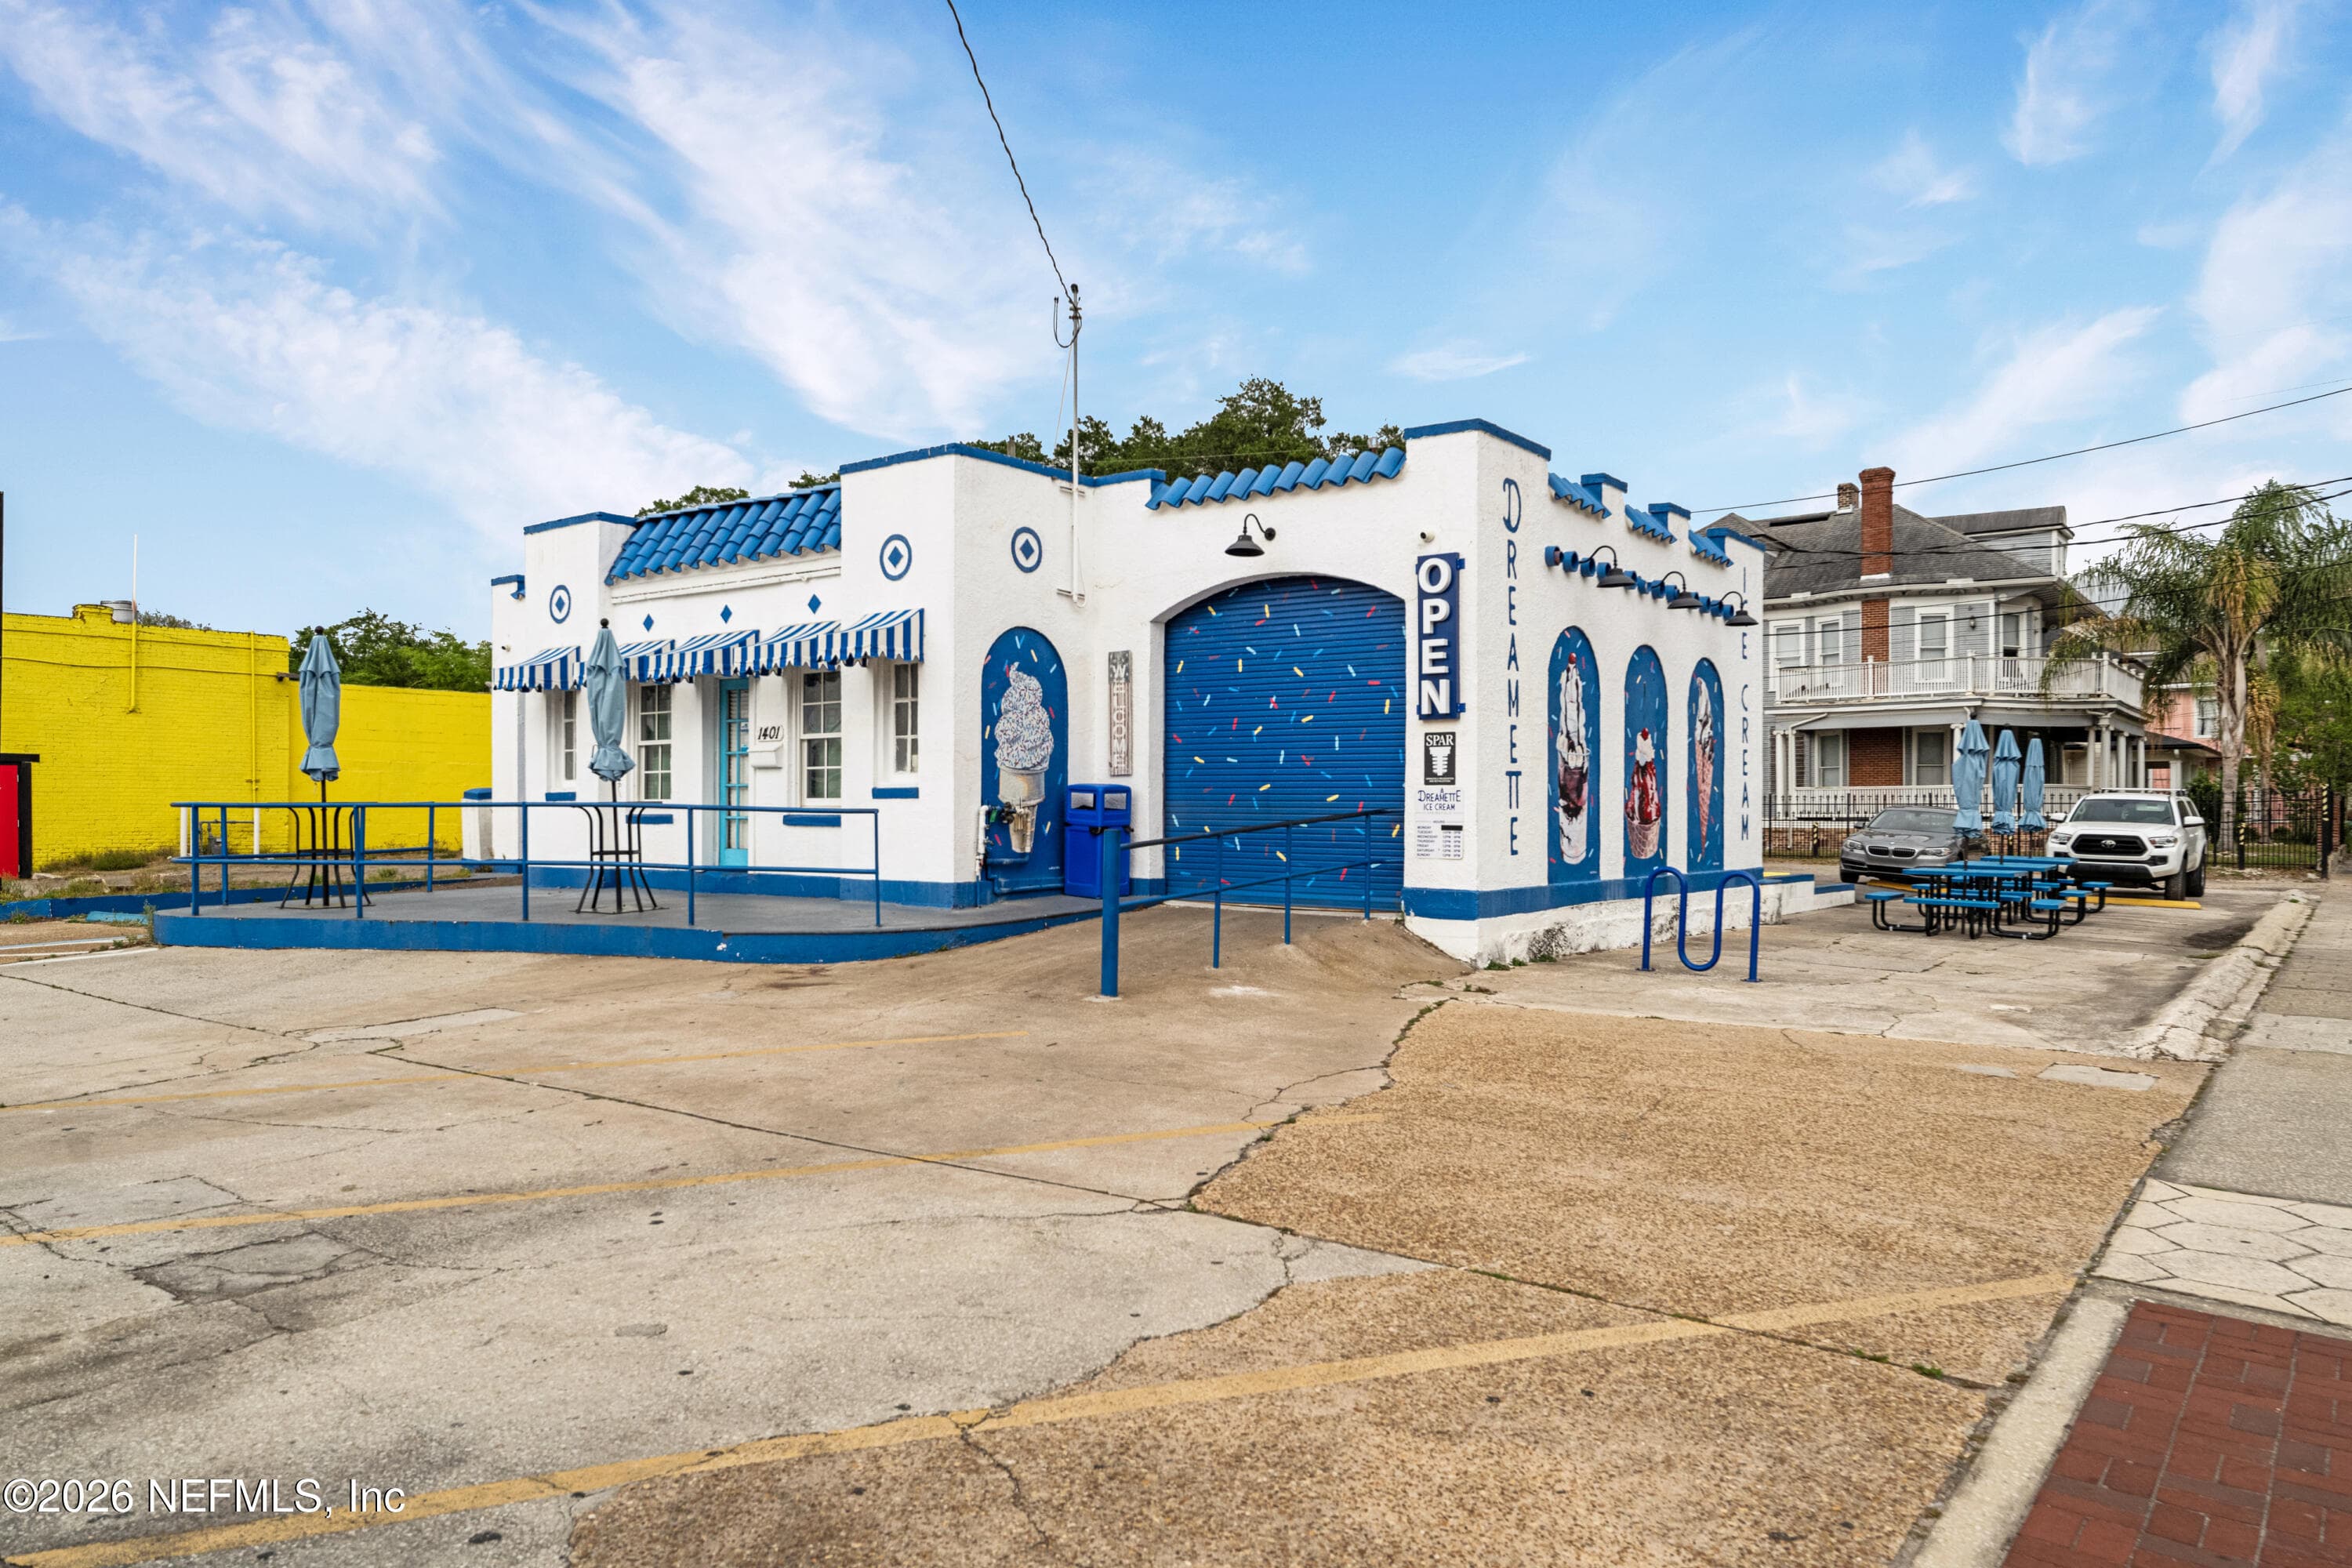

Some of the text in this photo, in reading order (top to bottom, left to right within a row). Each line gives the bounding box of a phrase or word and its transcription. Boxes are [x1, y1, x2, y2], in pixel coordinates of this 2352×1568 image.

[1418, 557, 1452, 715] OPEN
[1503, 477, 1523, 857] DREAMETTE
[757, 726, 781, 740] 1401
[1109, 664, 1127, 768] WELCOME
[1425, 734, 1454, 746] SPAR
[1741, 684, 1750, 841] CREAM
[1417, 788, 1461, 802] DREAMETTE
